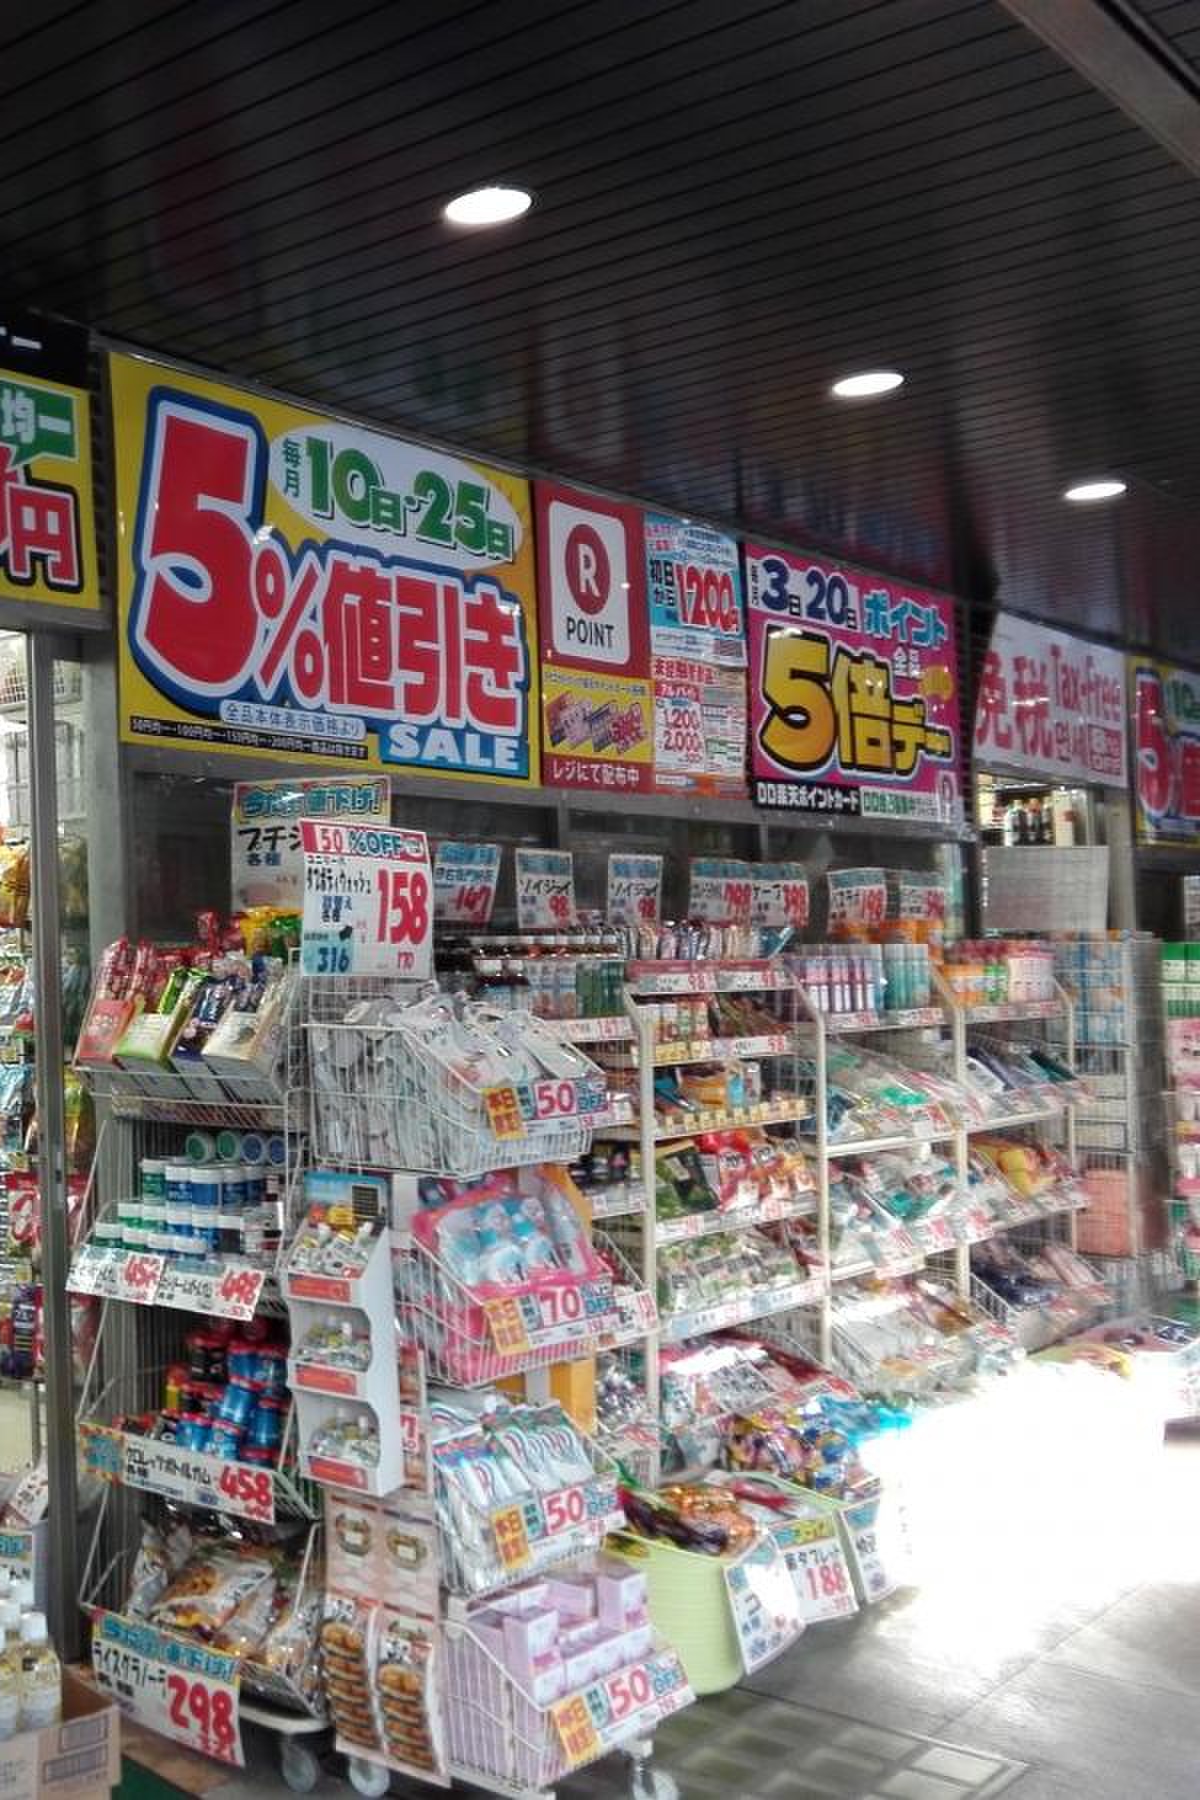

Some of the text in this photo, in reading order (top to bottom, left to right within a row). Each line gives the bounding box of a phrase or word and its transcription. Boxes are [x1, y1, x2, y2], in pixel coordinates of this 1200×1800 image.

[0, 388, 72, 445] 均一
[566, 616, 614, 649] POINT
[865, 590, 947, 648] ポイント
[760, 624, 952, 776] 5倍デー
[388, 725, 520, 771] SALE
[376, 867, 429, 945] 158
[316, 947, 350, 974] 316
[537, 1083, 575, 1116] 50
[542, 1287, 581, 1324] 70
[219, 1464, 271, 1506] 458
[546, 1494, 585, 1530] 50
[806, 1566, 848, 1601] 188
[167, 1674, 237, 1752] 298
[609, 1670, 651, 1717] 50
